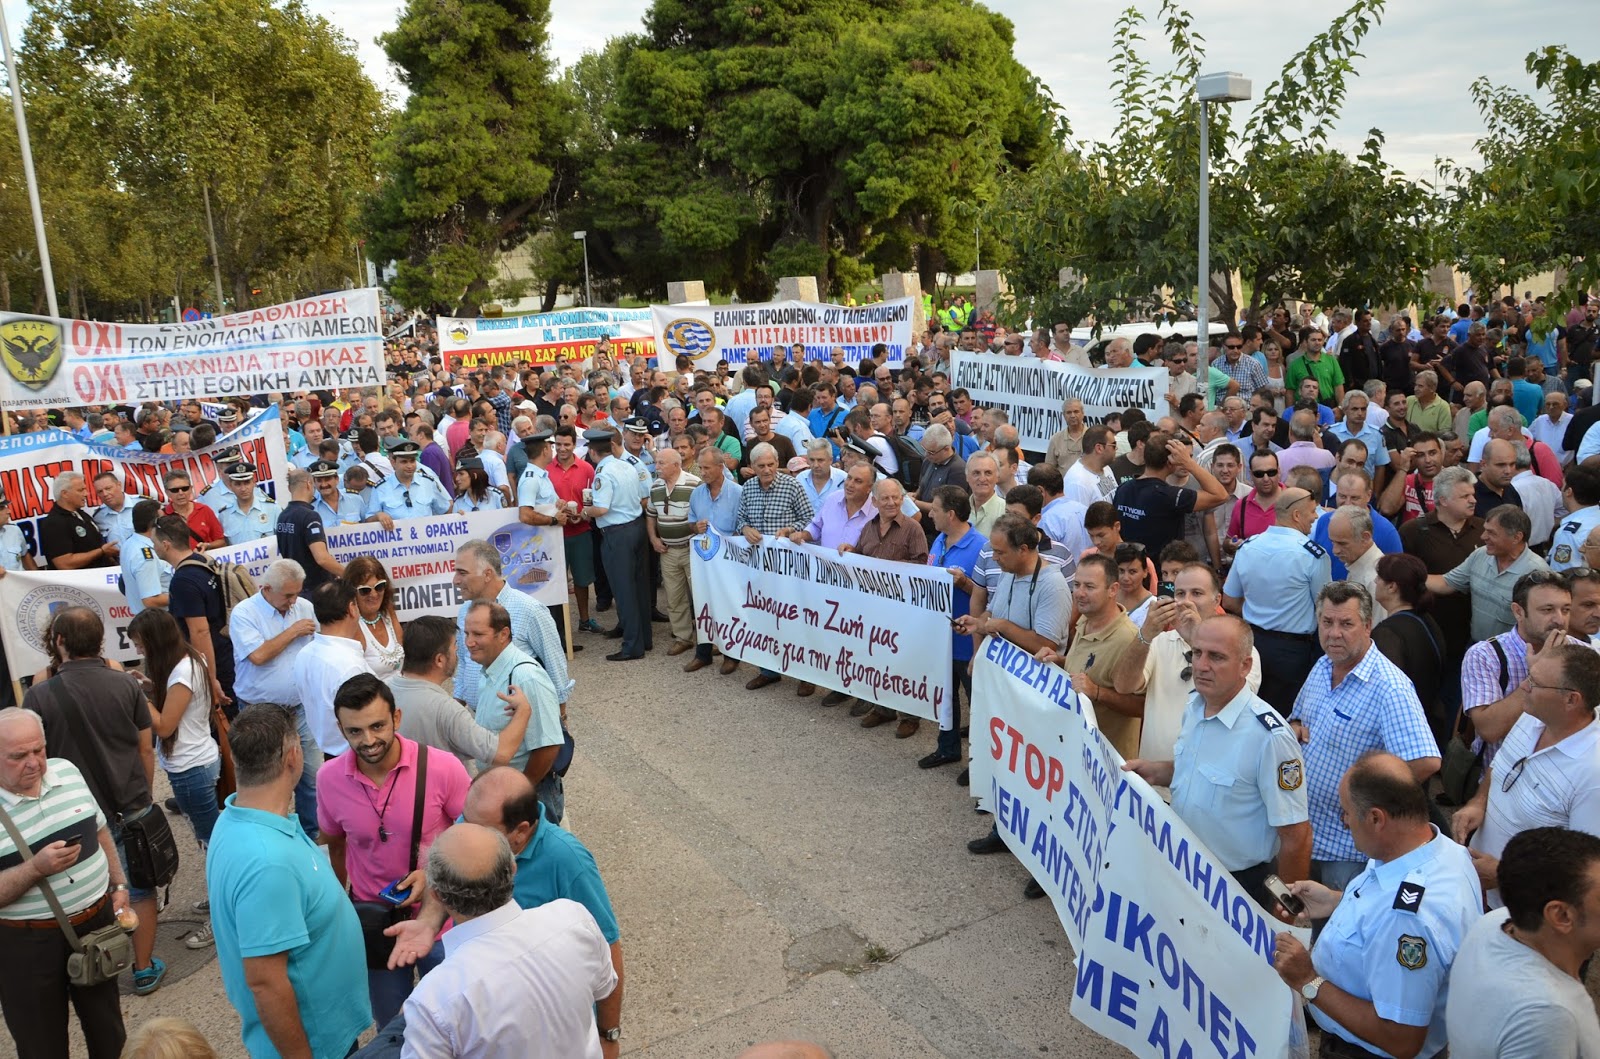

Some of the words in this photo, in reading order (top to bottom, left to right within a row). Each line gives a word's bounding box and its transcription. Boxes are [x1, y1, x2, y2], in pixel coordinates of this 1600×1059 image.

[521, 310, 608, 329] ΑΣΤΥΝΟΜΙΚΩΝ
[714, 309, 756, 327] ΕΛΛΗΝΕΣ
[758, 307, 817, 326] ΠΡΟΔΟΜΕΝΟΙ
[823, 307, 840, 324] ΟΧΙ
[842, 304, 909, 324] ΤΑΠΕΙΝΩΜΕΝΟΙ
[71, 319, 122, 356] ΟΧΙ
[128, 335, 166, 354] ΤΩΝ
[173, 328, 266, 351] ΕΝΟΠΛΩΝ
[271, 315, 379, 340] ΔΥΝΑΜΕΩΝ
[733, 326, 826, 346] ΑΝΤΙΣΤΑΘΕΙΤΕ
[829, 324, 893, 344] ΕΝΩΜΕΝΟΙ
[143, 355, 261, 379] ΠΑΙΧΝΙΔΙΑ
[268, 345, 368, 368] ΤΡΟΙΚΑΣ
[535, 347, 556, 363] ΣΑΣ
[73, 364, 127, 403] ΟΧΙ
[136, 378, 197, 400] ΣΤΗΝ
[203, 372, 291, 395] ΕΘΝΙΚΗ
[299, 364, 381, 388] ΑΜΥΝΑ
[956, 360, 983, 390] ΕΝΩΣΗ
[983, 362, 1046, 398] ΑΣΤΥΝΟΜΙΚΩΝ
[1046, 369, 1105, 406] ΥΠΑΛΛΗΛΩΝ
[1104, 377, 1156, 410] ΠΡΕΒΕΖΑΣ
[1011, 405, 1045, 440] ΑΥΤΟΥΣ
[327, 527, 403, 549] ΜΑΚΕΔΟΝΙΑΣ
[410, 526, 418, 540] &
[425, 520, 469, 538] ΘΡΑΚΗΣ
[908, 575, 952, 614] ΑΓΡΙΝΙΟΥ
[697, 602, 780, 659] Αγνιζόμαστε
[782, 641, 806, 673] για
[809, 648, 832, 672] την
[803, 606, 819, 628] τη
[824, 599, 864, 640] Ζωή
[868, 625, 899, 657] μας
[989, 716, 1064, 803] STOP
[986, 636, 1051, 694] ΕΝΩΣΗ
[1114, 778, 1276, 966] ΥΠΑΛΛΗΛΩΝ
